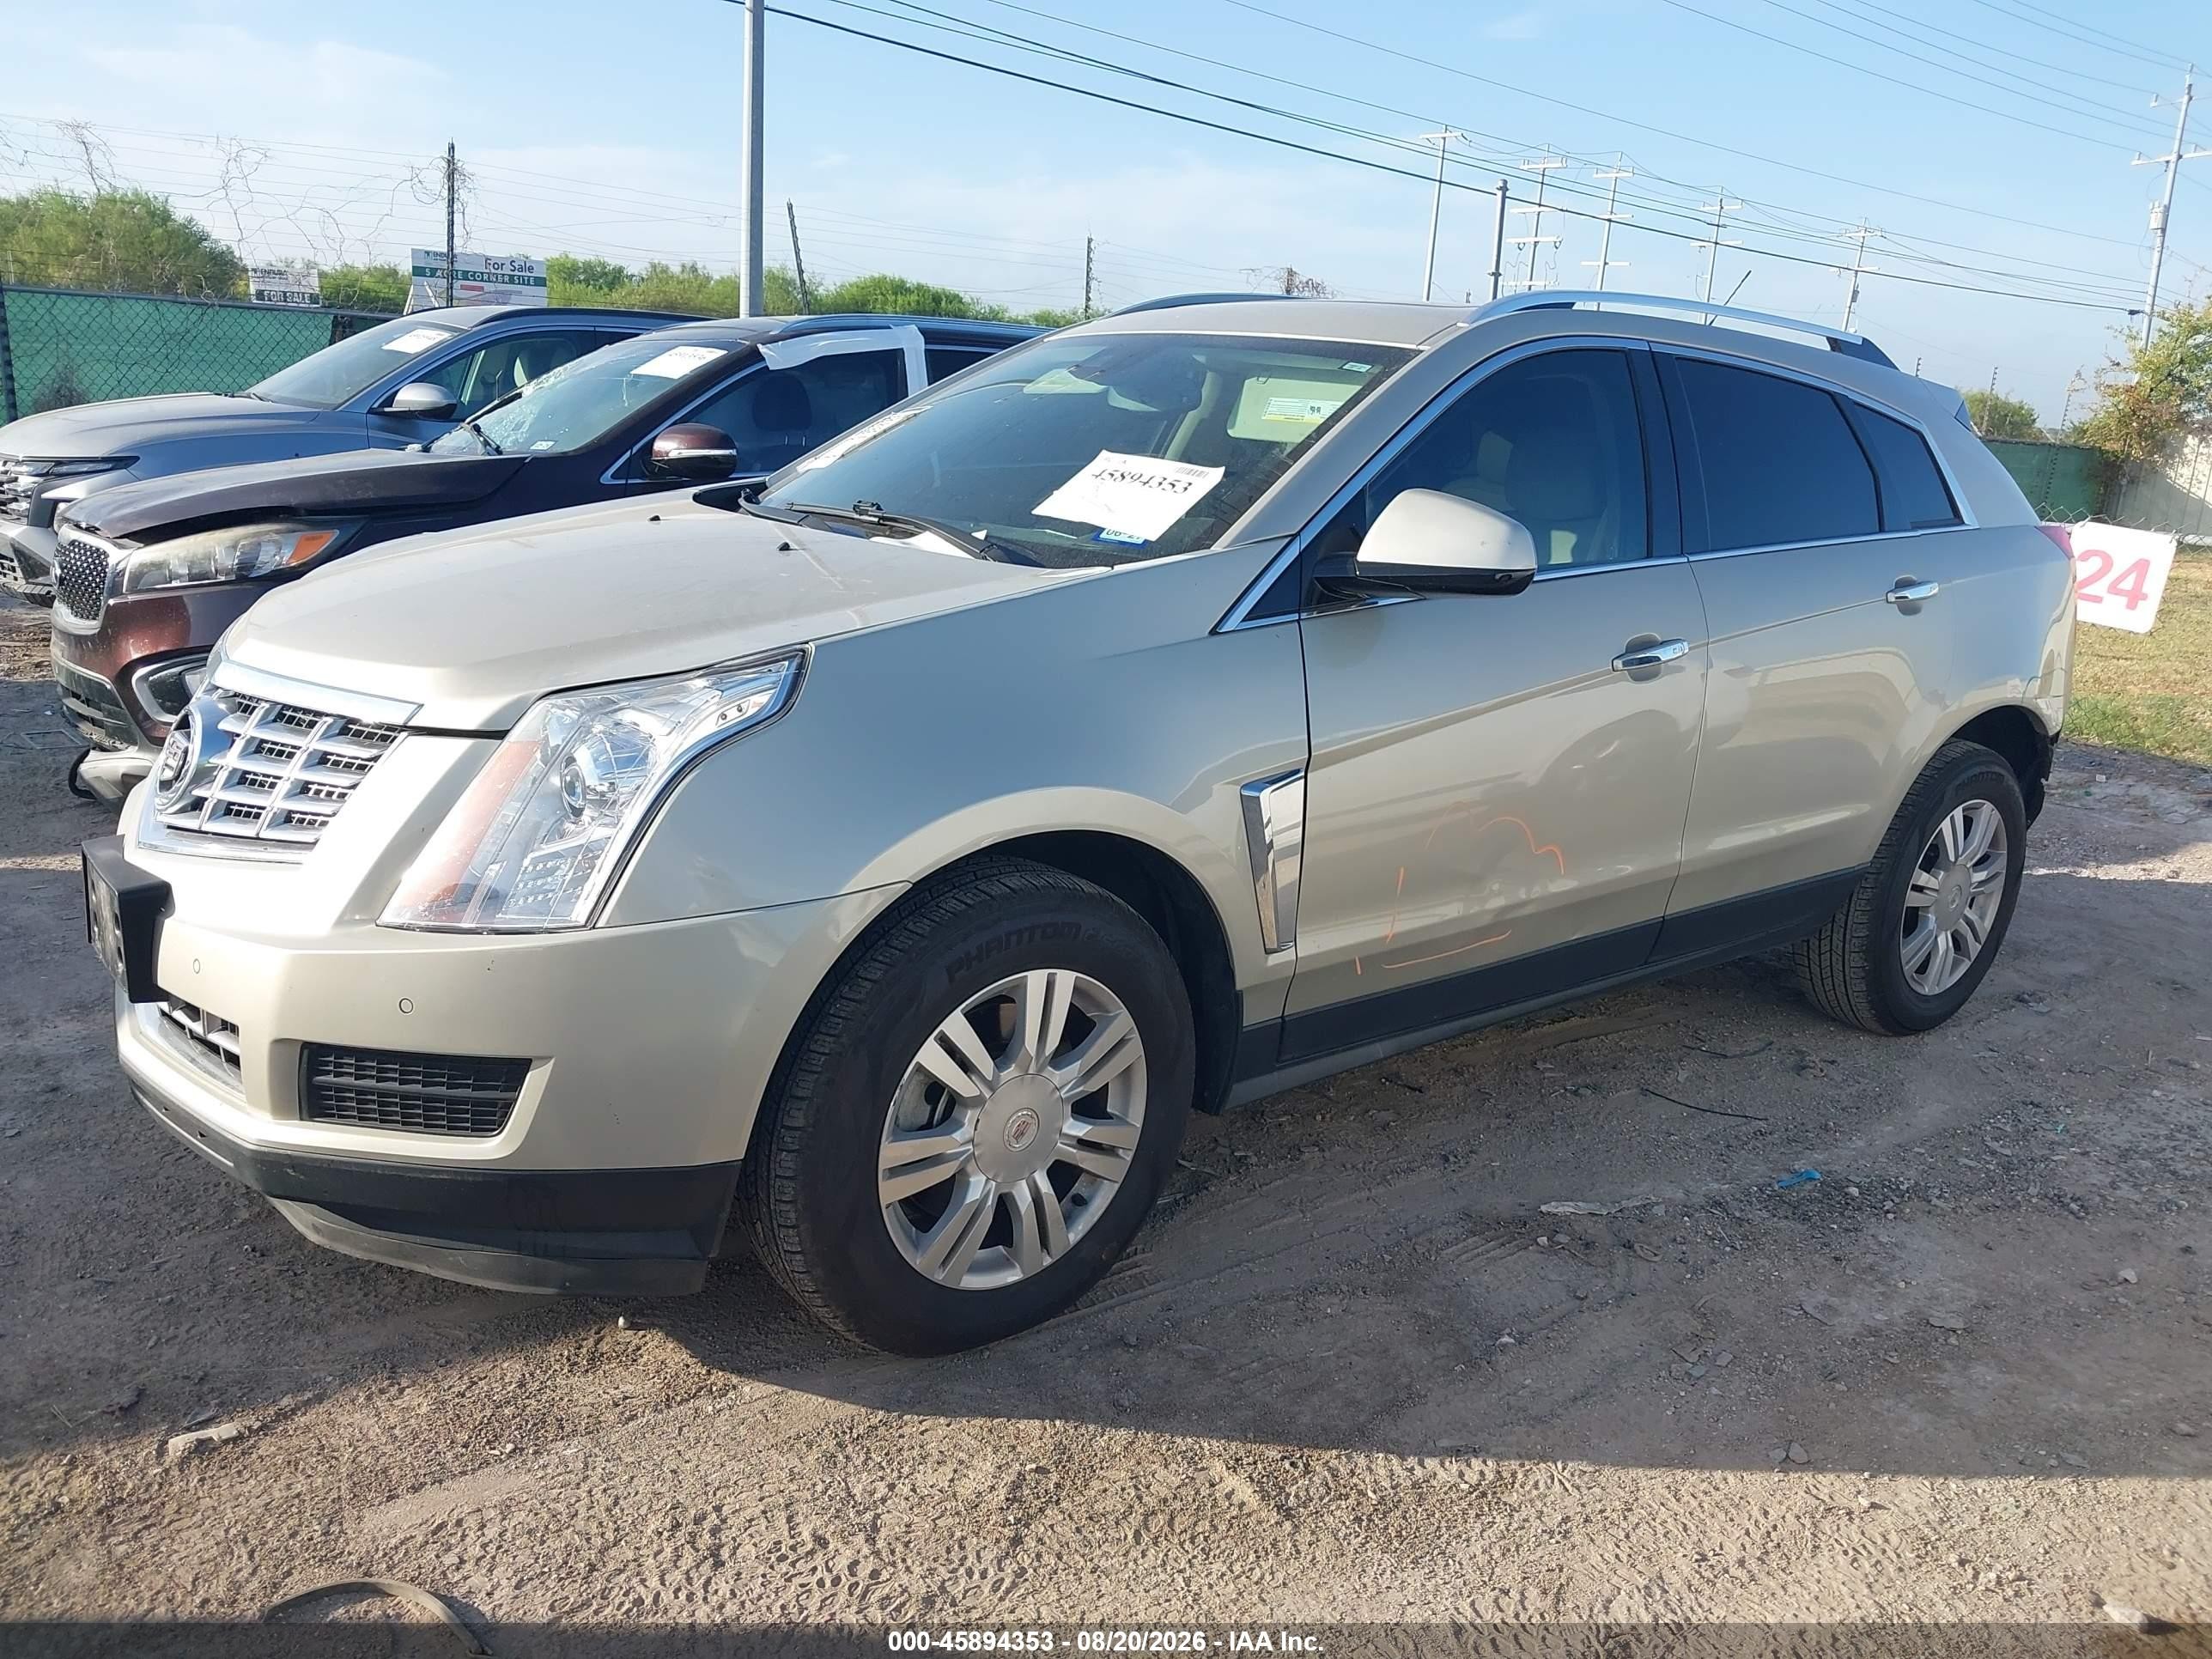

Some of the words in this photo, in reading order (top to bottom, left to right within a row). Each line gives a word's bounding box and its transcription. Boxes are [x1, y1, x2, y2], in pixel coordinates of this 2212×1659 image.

[425, 268, 431, 276] 5
[434, 269, 463, 279] ACRE
[468, 272, 509, 283] CORNER
[514, 276, 535, 285] SITE
[484, 258, 505, 271] For
[509, 259, 535, 274] Sale
[264, 290, 284, 301] FOR
[286, 292, 311, 303] SALE
[1092, 469, 1193, 494] 45894353
[2074, 549, 2151, 611] 24
[945, 921, 1083, 983] PHANTOM
